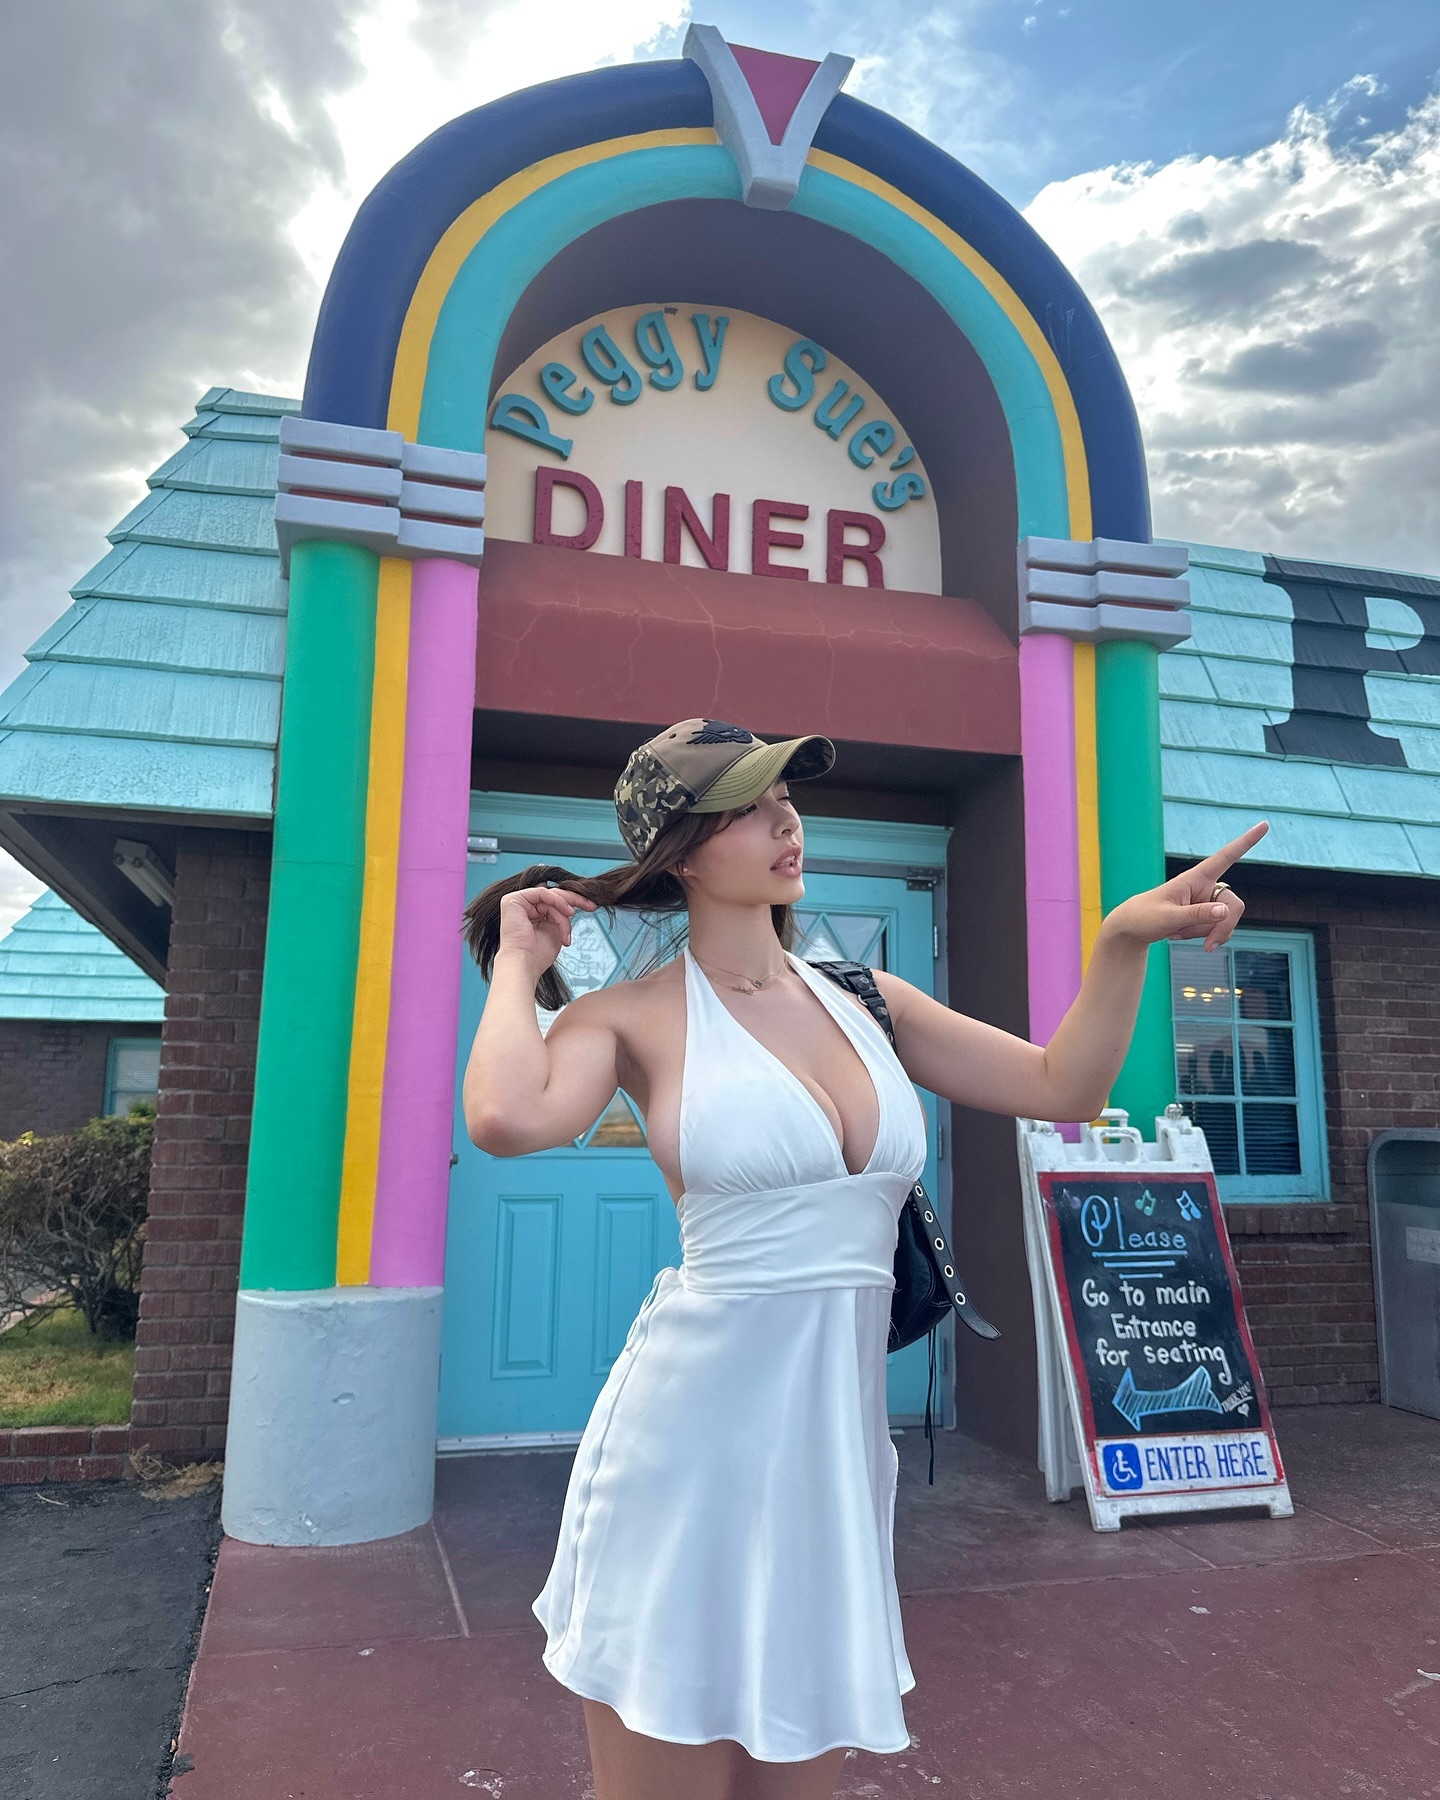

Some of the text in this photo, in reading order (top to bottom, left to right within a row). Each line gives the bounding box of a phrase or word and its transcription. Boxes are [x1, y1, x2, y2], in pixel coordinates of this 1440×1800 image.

[768, 339, 925, 511] Sue's
[533, 466, 886, 589] DINER
[1081, 1194, 1187, 1250] Please
[1082, 1278, 1210, 1307] Go to main
[1110, 1313, 1197, 1339] Entrance
[1095, 1338, 1232, 1385] for seating
[1144, 1441, 1267, 1482] ENTER HERE
